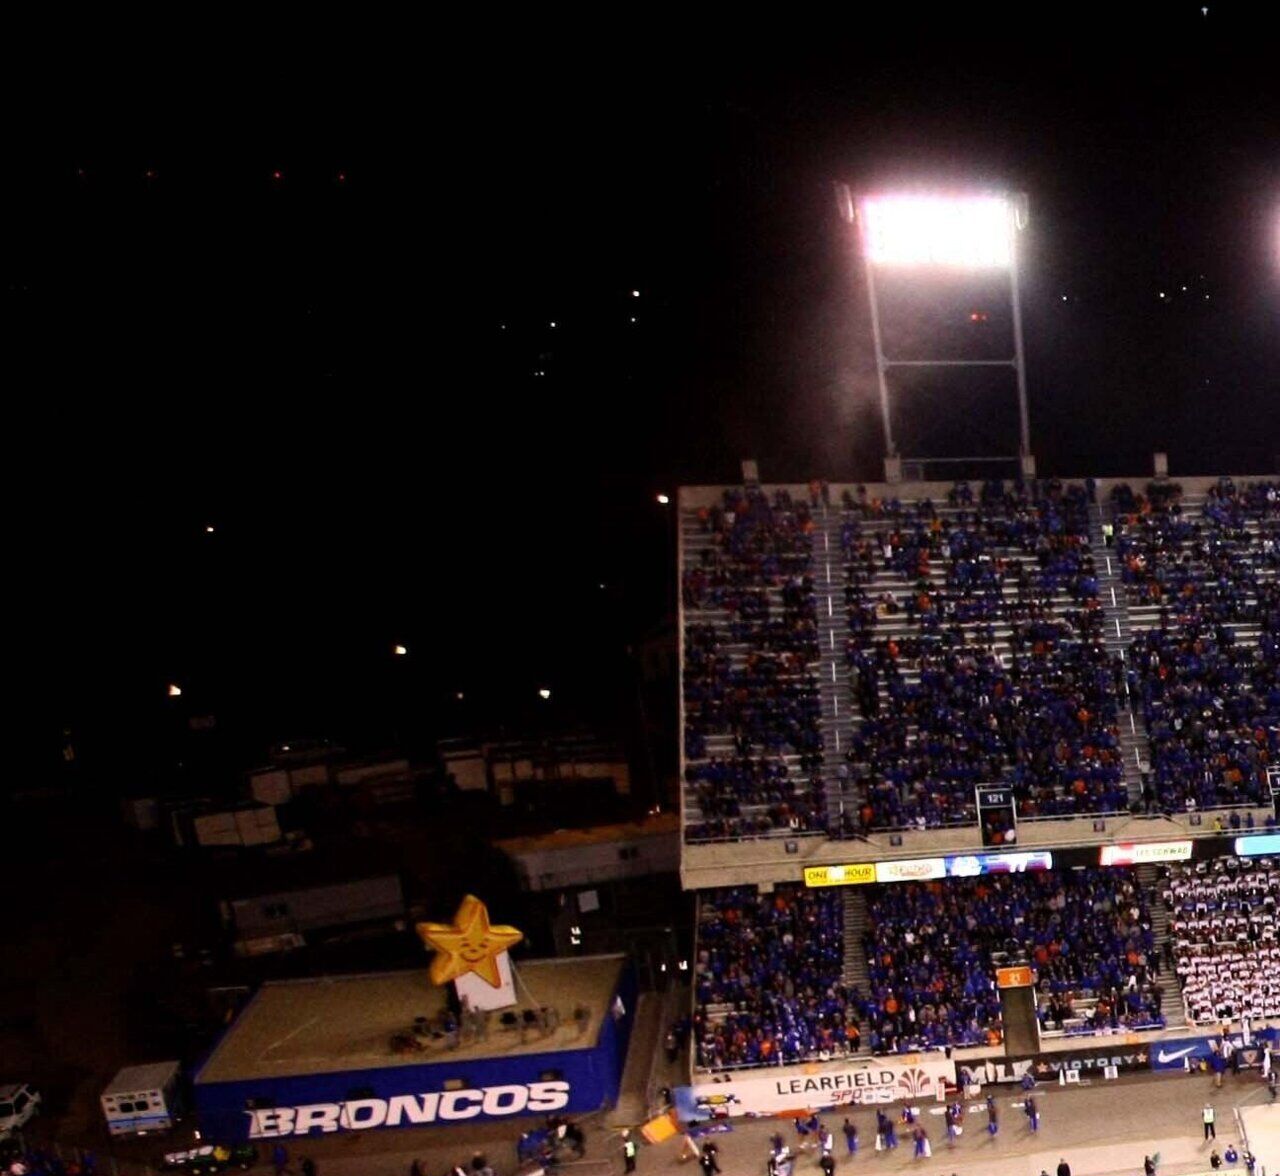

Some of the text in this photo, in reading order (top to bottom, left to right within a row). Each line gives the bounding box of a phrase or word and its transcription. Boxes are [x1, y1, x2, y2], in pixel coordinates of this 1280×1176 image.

[987, 794, 1004, 803] 121
[776, 1071, 895, 1096] LEARFIELD
[248, 1081, 571, 1140] BRONCOS
